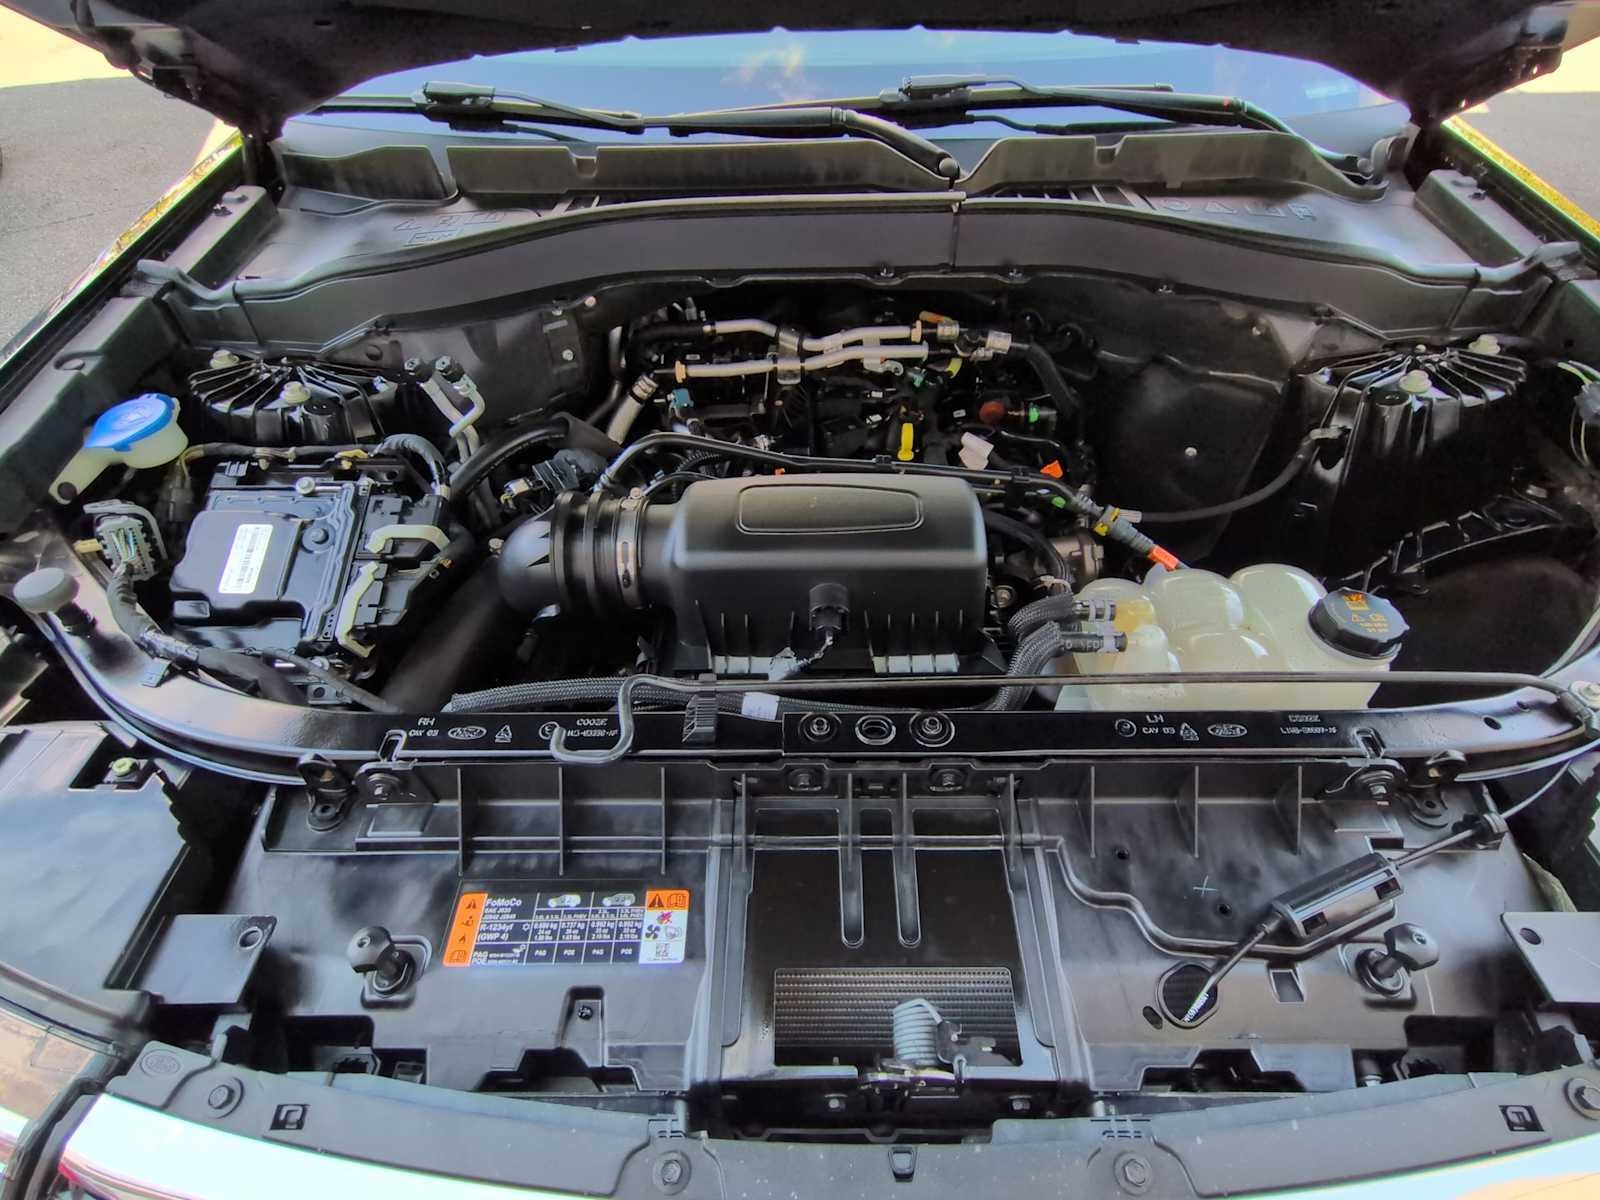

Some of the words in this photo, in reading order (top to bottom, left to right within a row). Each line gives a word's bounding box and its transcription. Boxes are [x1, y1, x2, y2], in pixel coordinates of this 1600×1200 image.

[1146, 714, 1165, 723] LH
[486, 897, 522, 907] FoMoCo
[478, 933, 500, 942] (GWP
[500, 933, 510, 942] 4)
